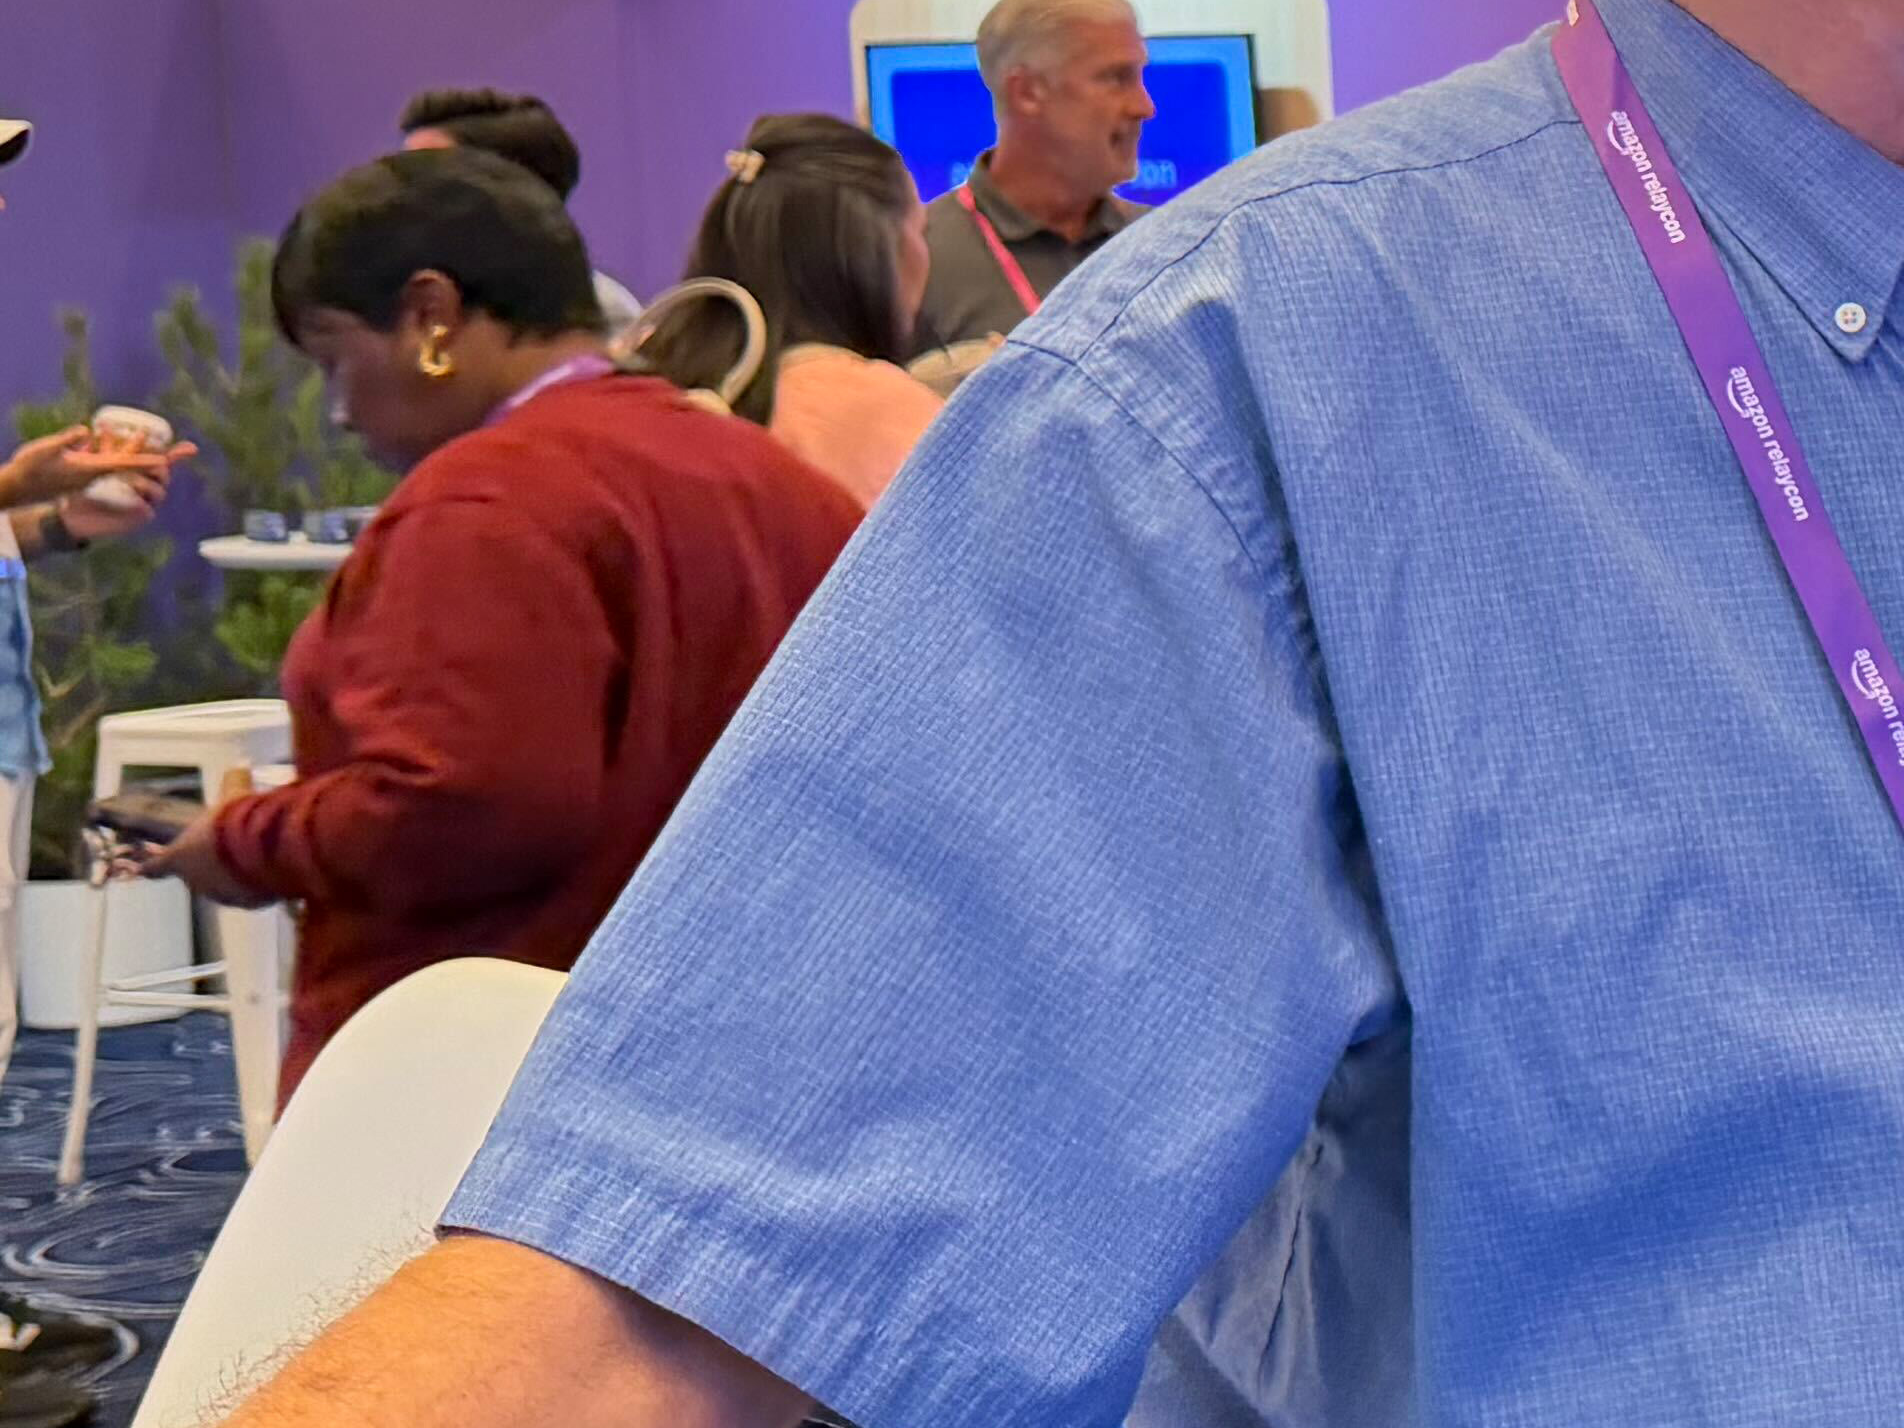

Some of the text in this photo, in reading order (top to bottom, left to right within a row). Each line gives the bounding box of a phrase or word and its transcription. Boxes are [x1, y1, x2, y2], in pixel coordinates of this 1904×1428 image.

[1609, 110, 1687, 244] amazon relaycon
[1729, 366, 1810, 522] amazon relaycon
[1854, 648, 1900, 719] amazon
